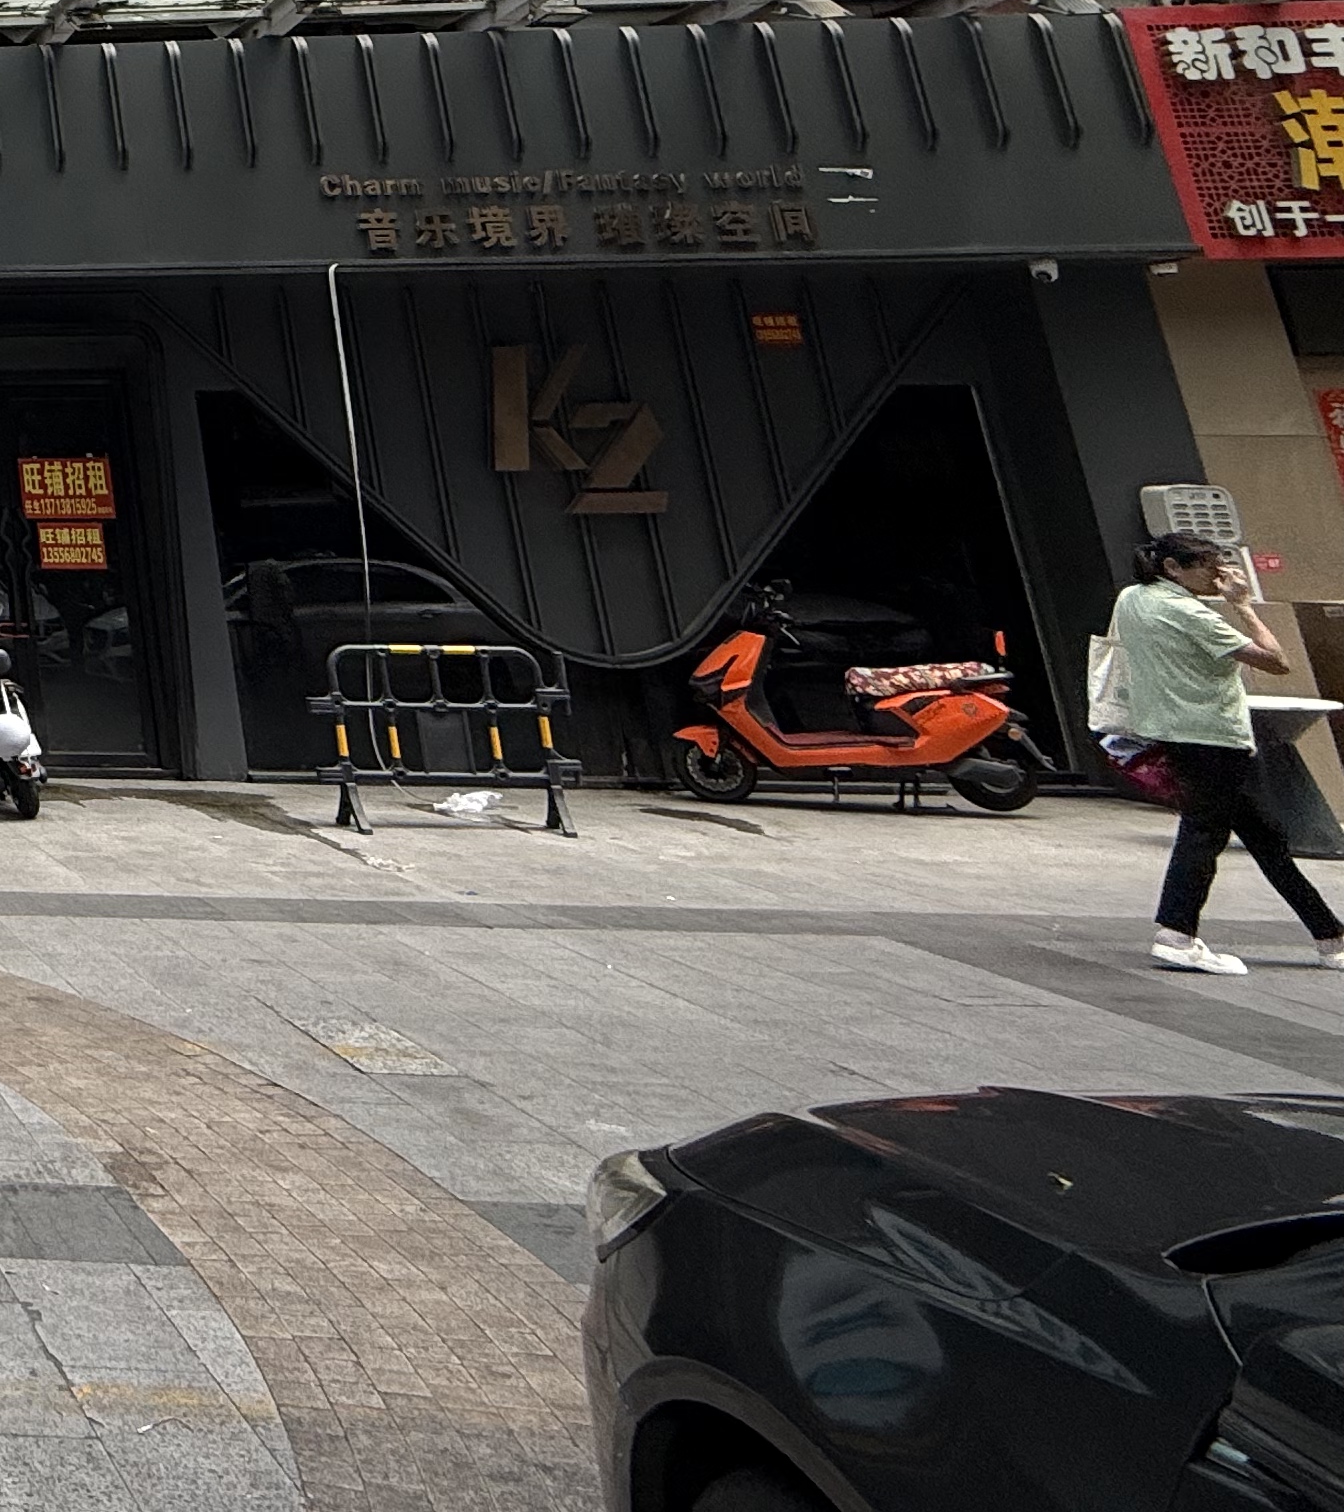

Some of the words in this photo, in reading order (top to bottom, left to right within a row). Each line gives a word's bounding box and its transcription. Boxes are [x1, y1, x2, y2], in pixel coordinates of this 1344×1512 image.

[320, 173, 423, 197] Charm
[22, 460, 110, 496] 旺铺招租
[38, 527, 103, 545] 旺铺招租
